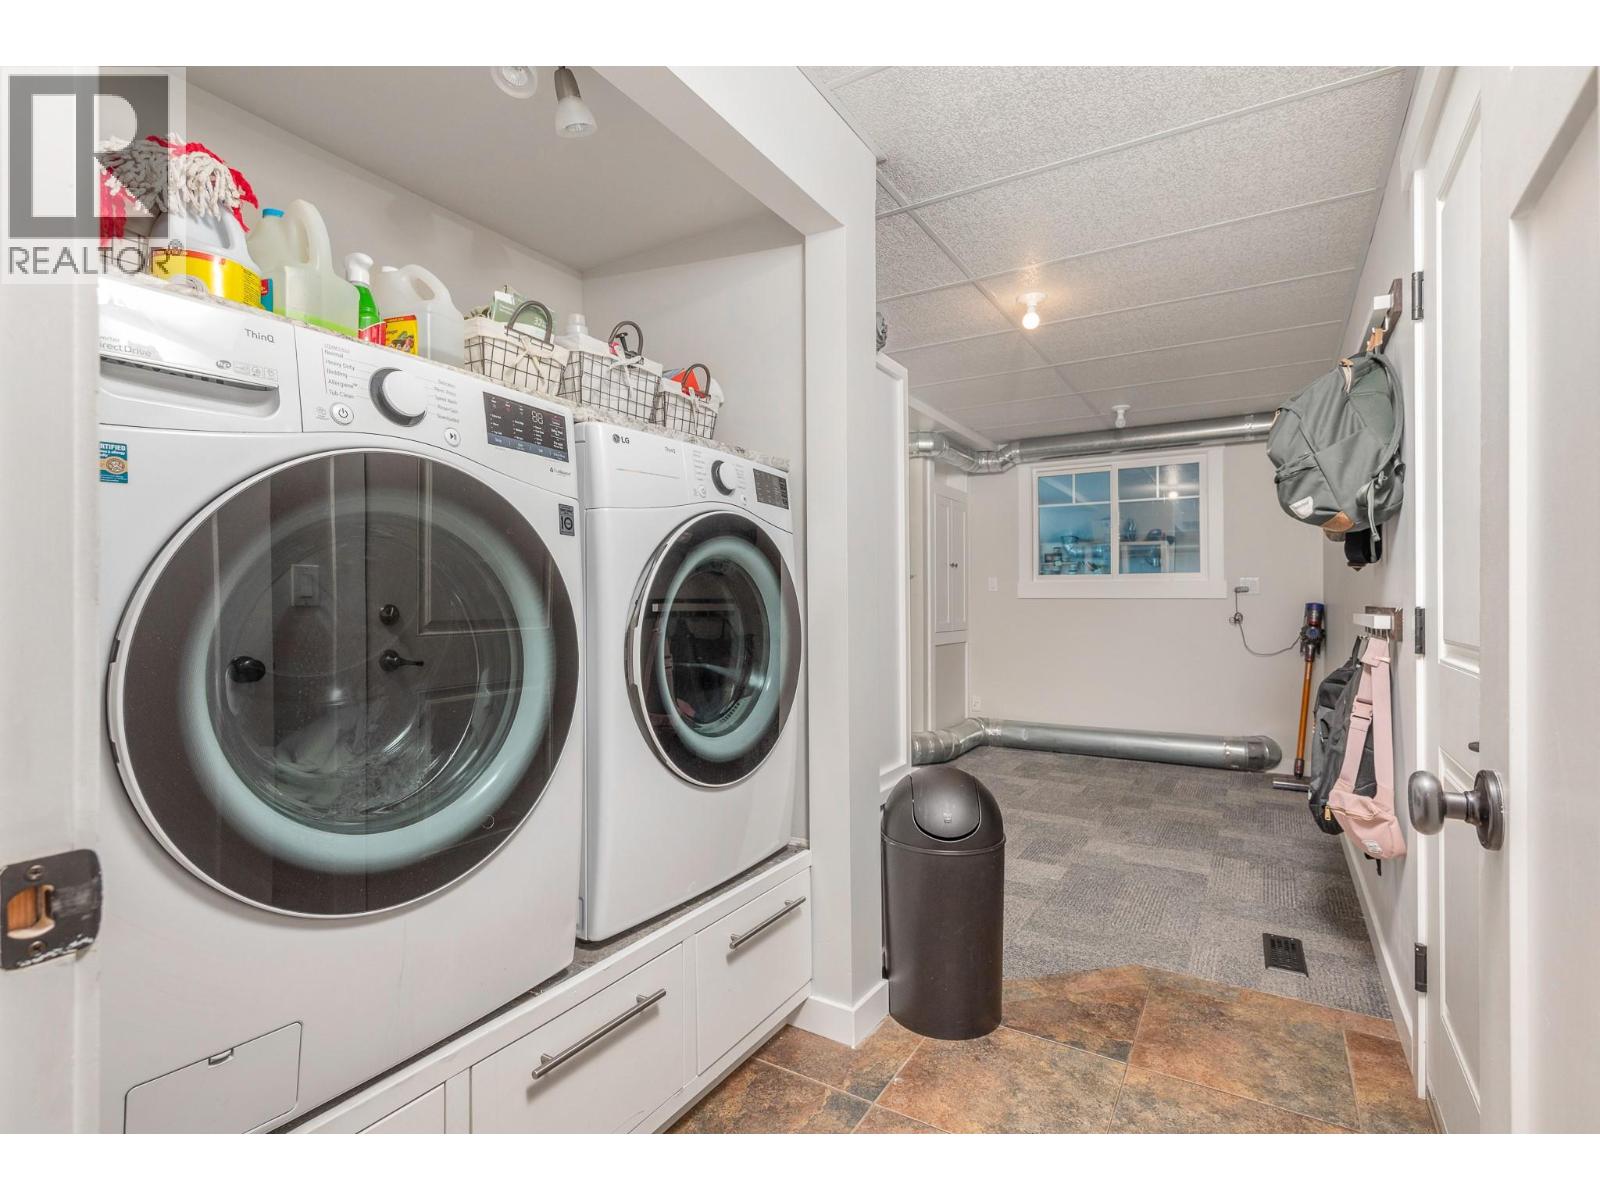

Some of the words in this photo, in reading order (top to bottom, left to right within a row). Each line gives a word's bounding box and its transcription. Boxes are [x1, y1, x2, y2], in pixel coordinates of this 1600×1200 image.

[244, 328, 275, 343] ThinQ
[99, 342, 122, 352] irect
[124, 345, 153, 358] Drive
[621, 436, 630, 444] LG
